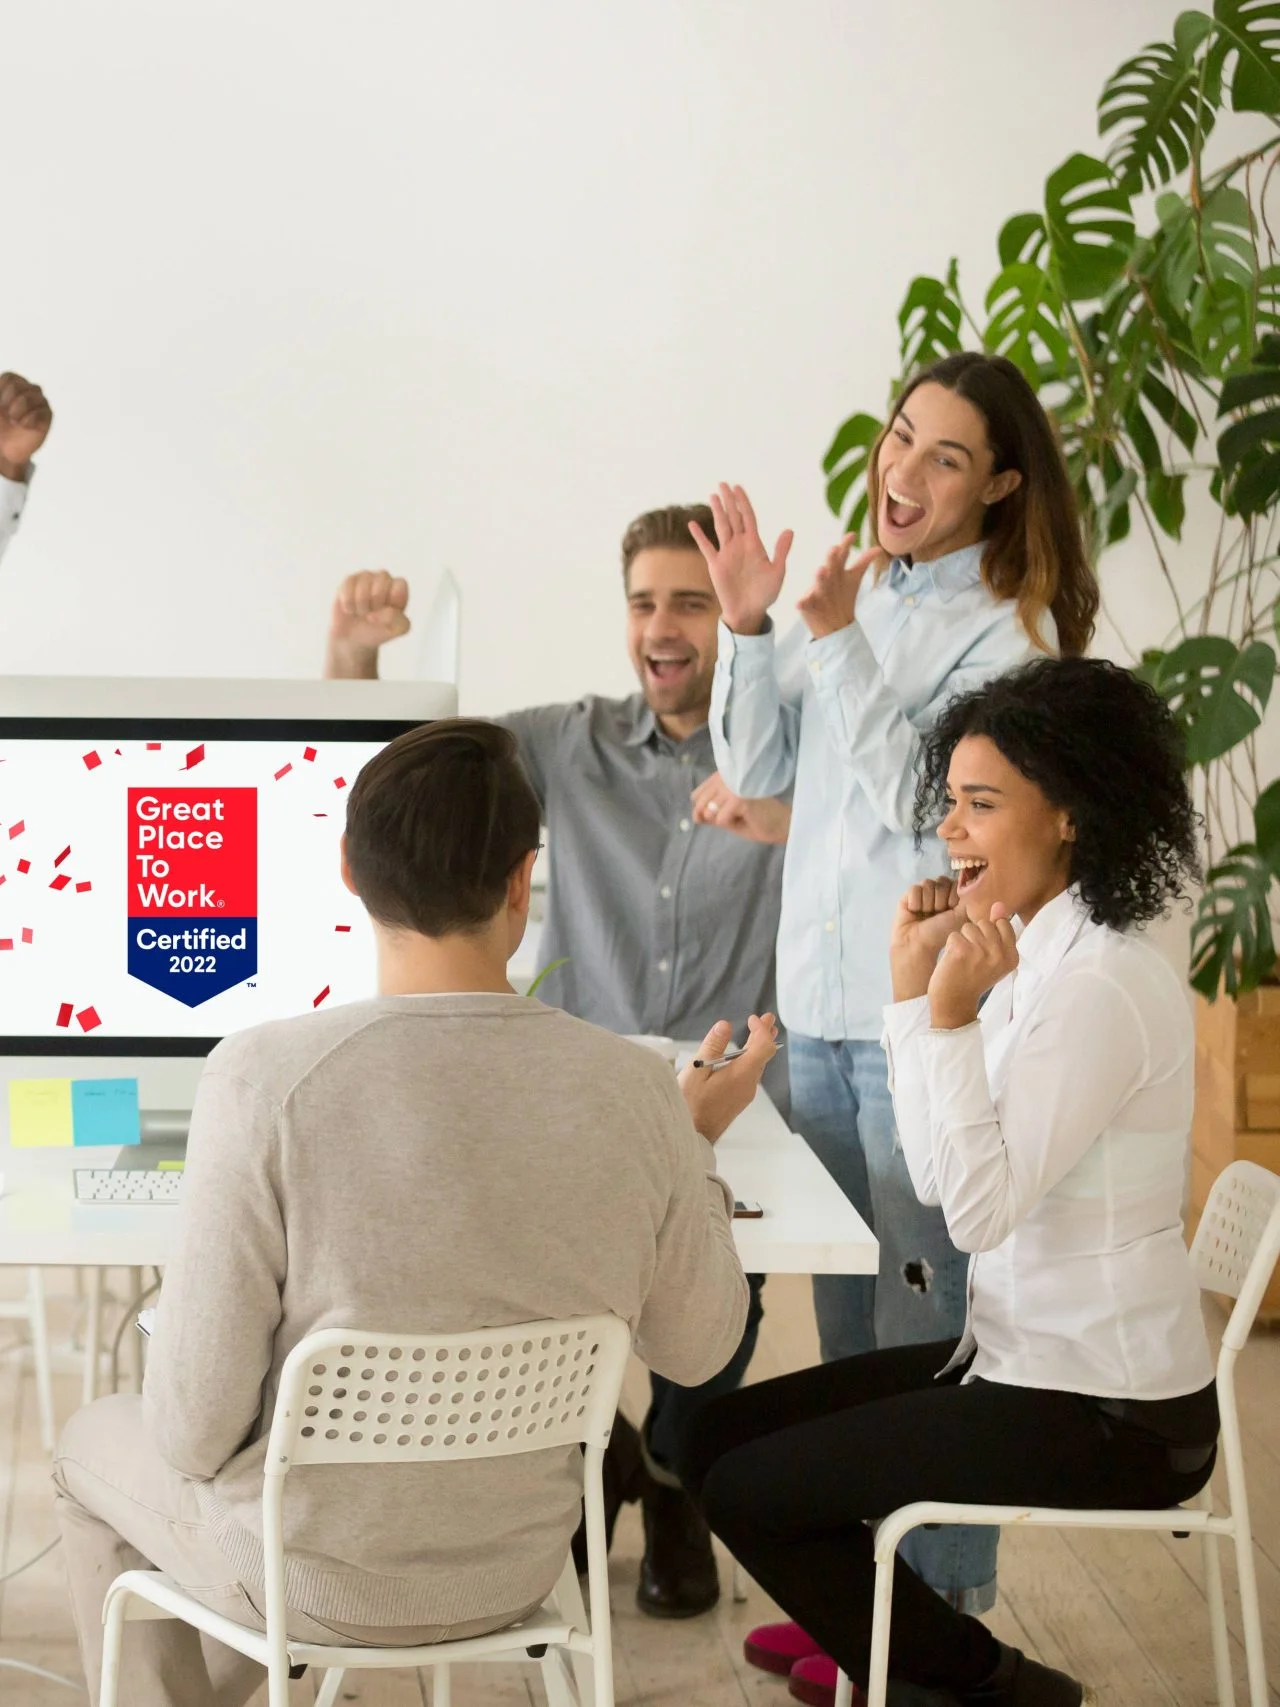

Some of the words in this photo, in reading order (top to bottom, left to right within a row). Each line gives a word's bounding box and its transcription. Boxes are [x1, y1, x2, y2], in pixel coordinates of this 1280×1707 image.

[136, 796, 224, 821] Great
[138, 825, 224, 849] Place
[136, 854, 170, 878] To
[136, 928, 246, 950] Certified
[169, 955, 216, 973] 2022
